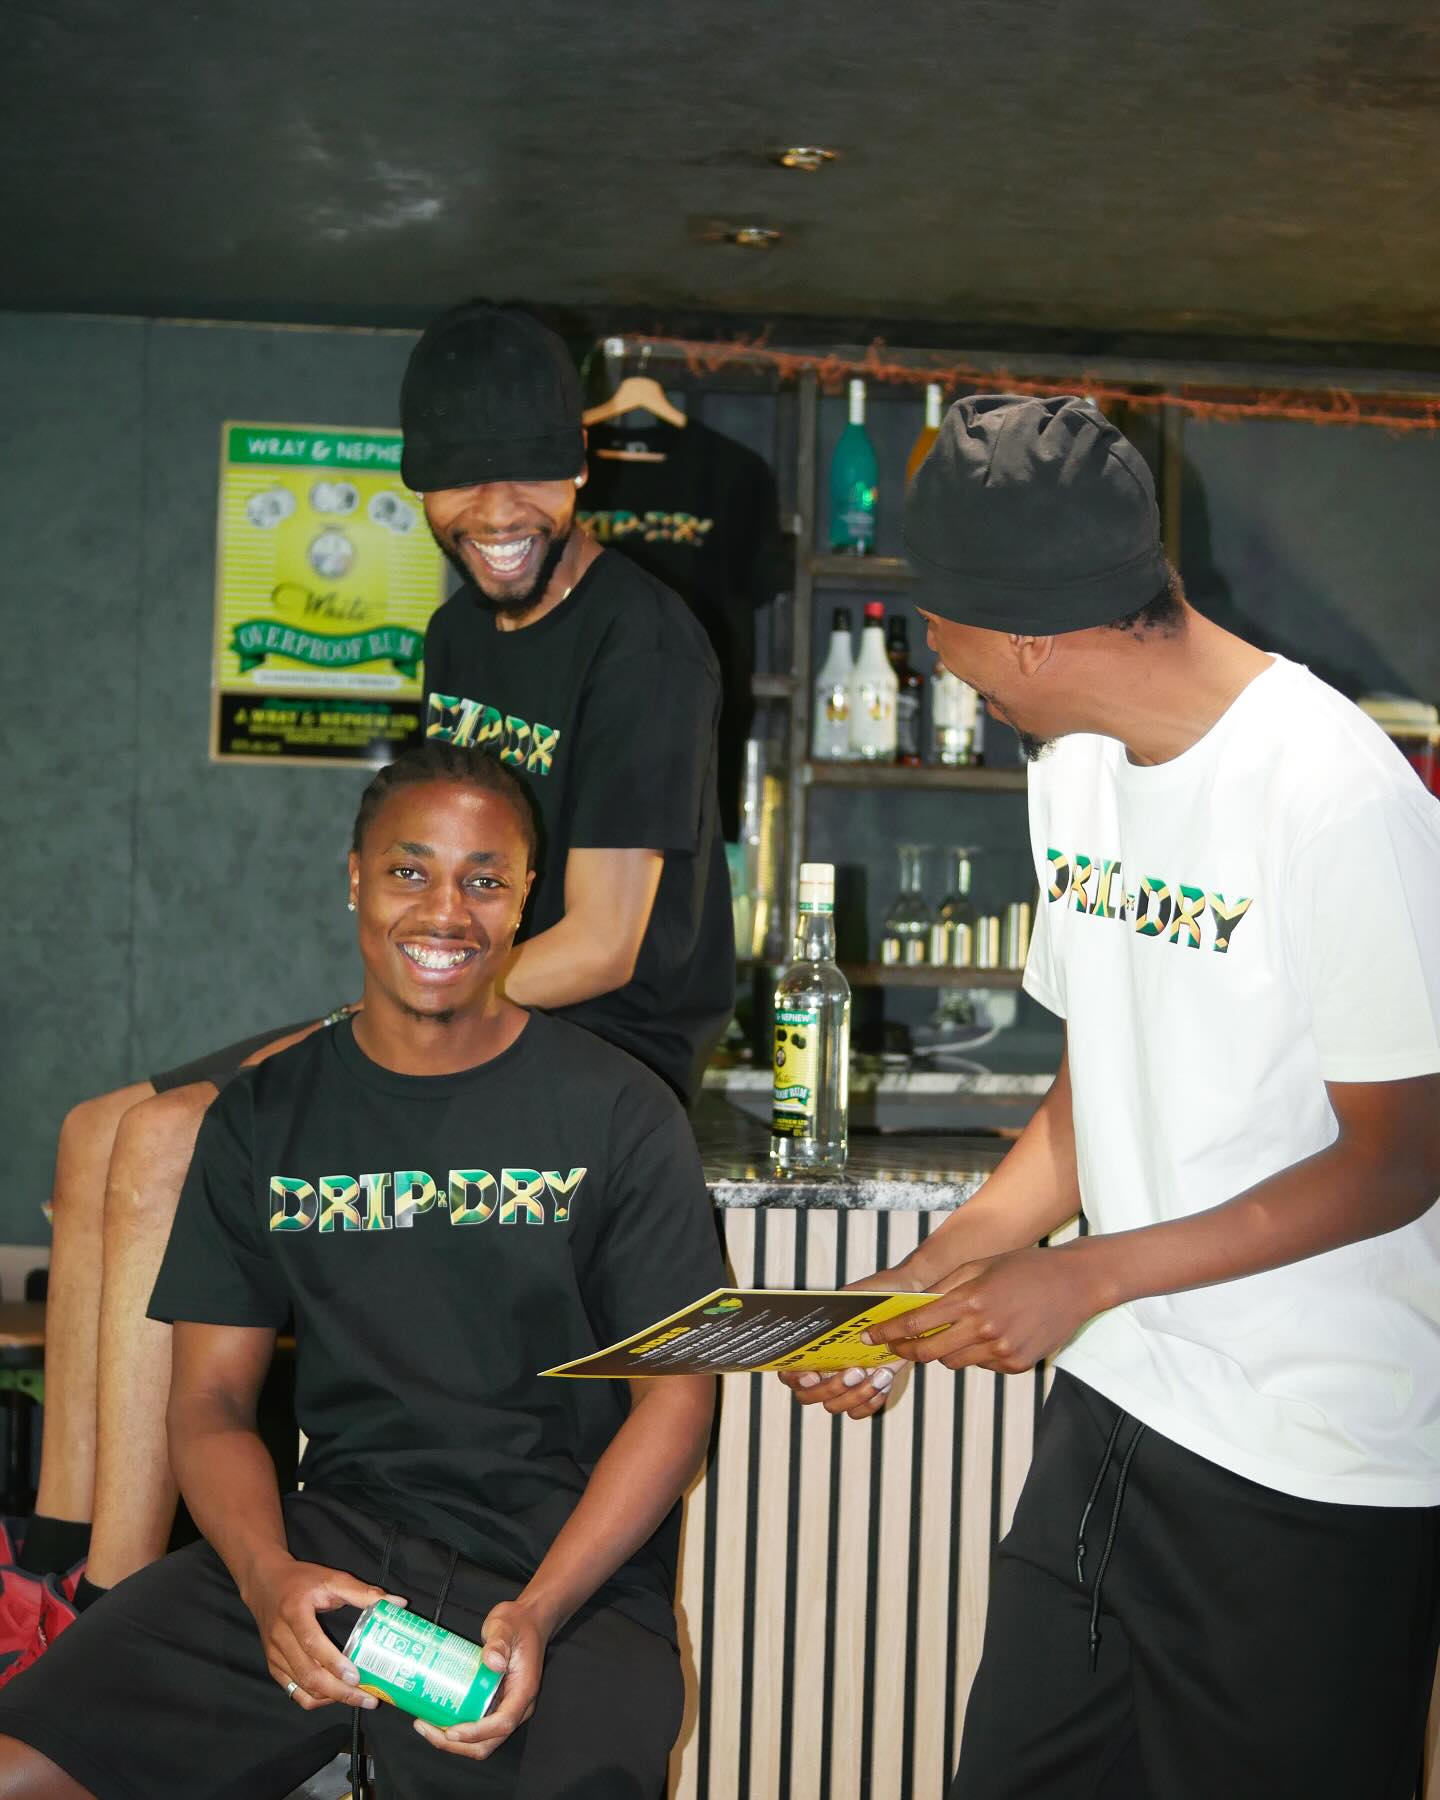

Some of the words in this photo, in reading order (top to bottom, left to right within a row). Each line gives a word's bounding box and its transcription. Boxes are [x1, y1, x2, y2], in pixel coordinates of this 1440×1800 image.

[247, 437, 306, 457] WRAY
[311, 440, 332, 461] &
[336, 442, 403, 462] NEPHE
[239, 624, 363, 661] OVERPROOF
[368, 631, 417, 658] RUM
[781, 1012, 809, 1023] NEPHEW
[847, 1317, 873, 1329] IT
[628, 1326, 691, 1354] SIDES
